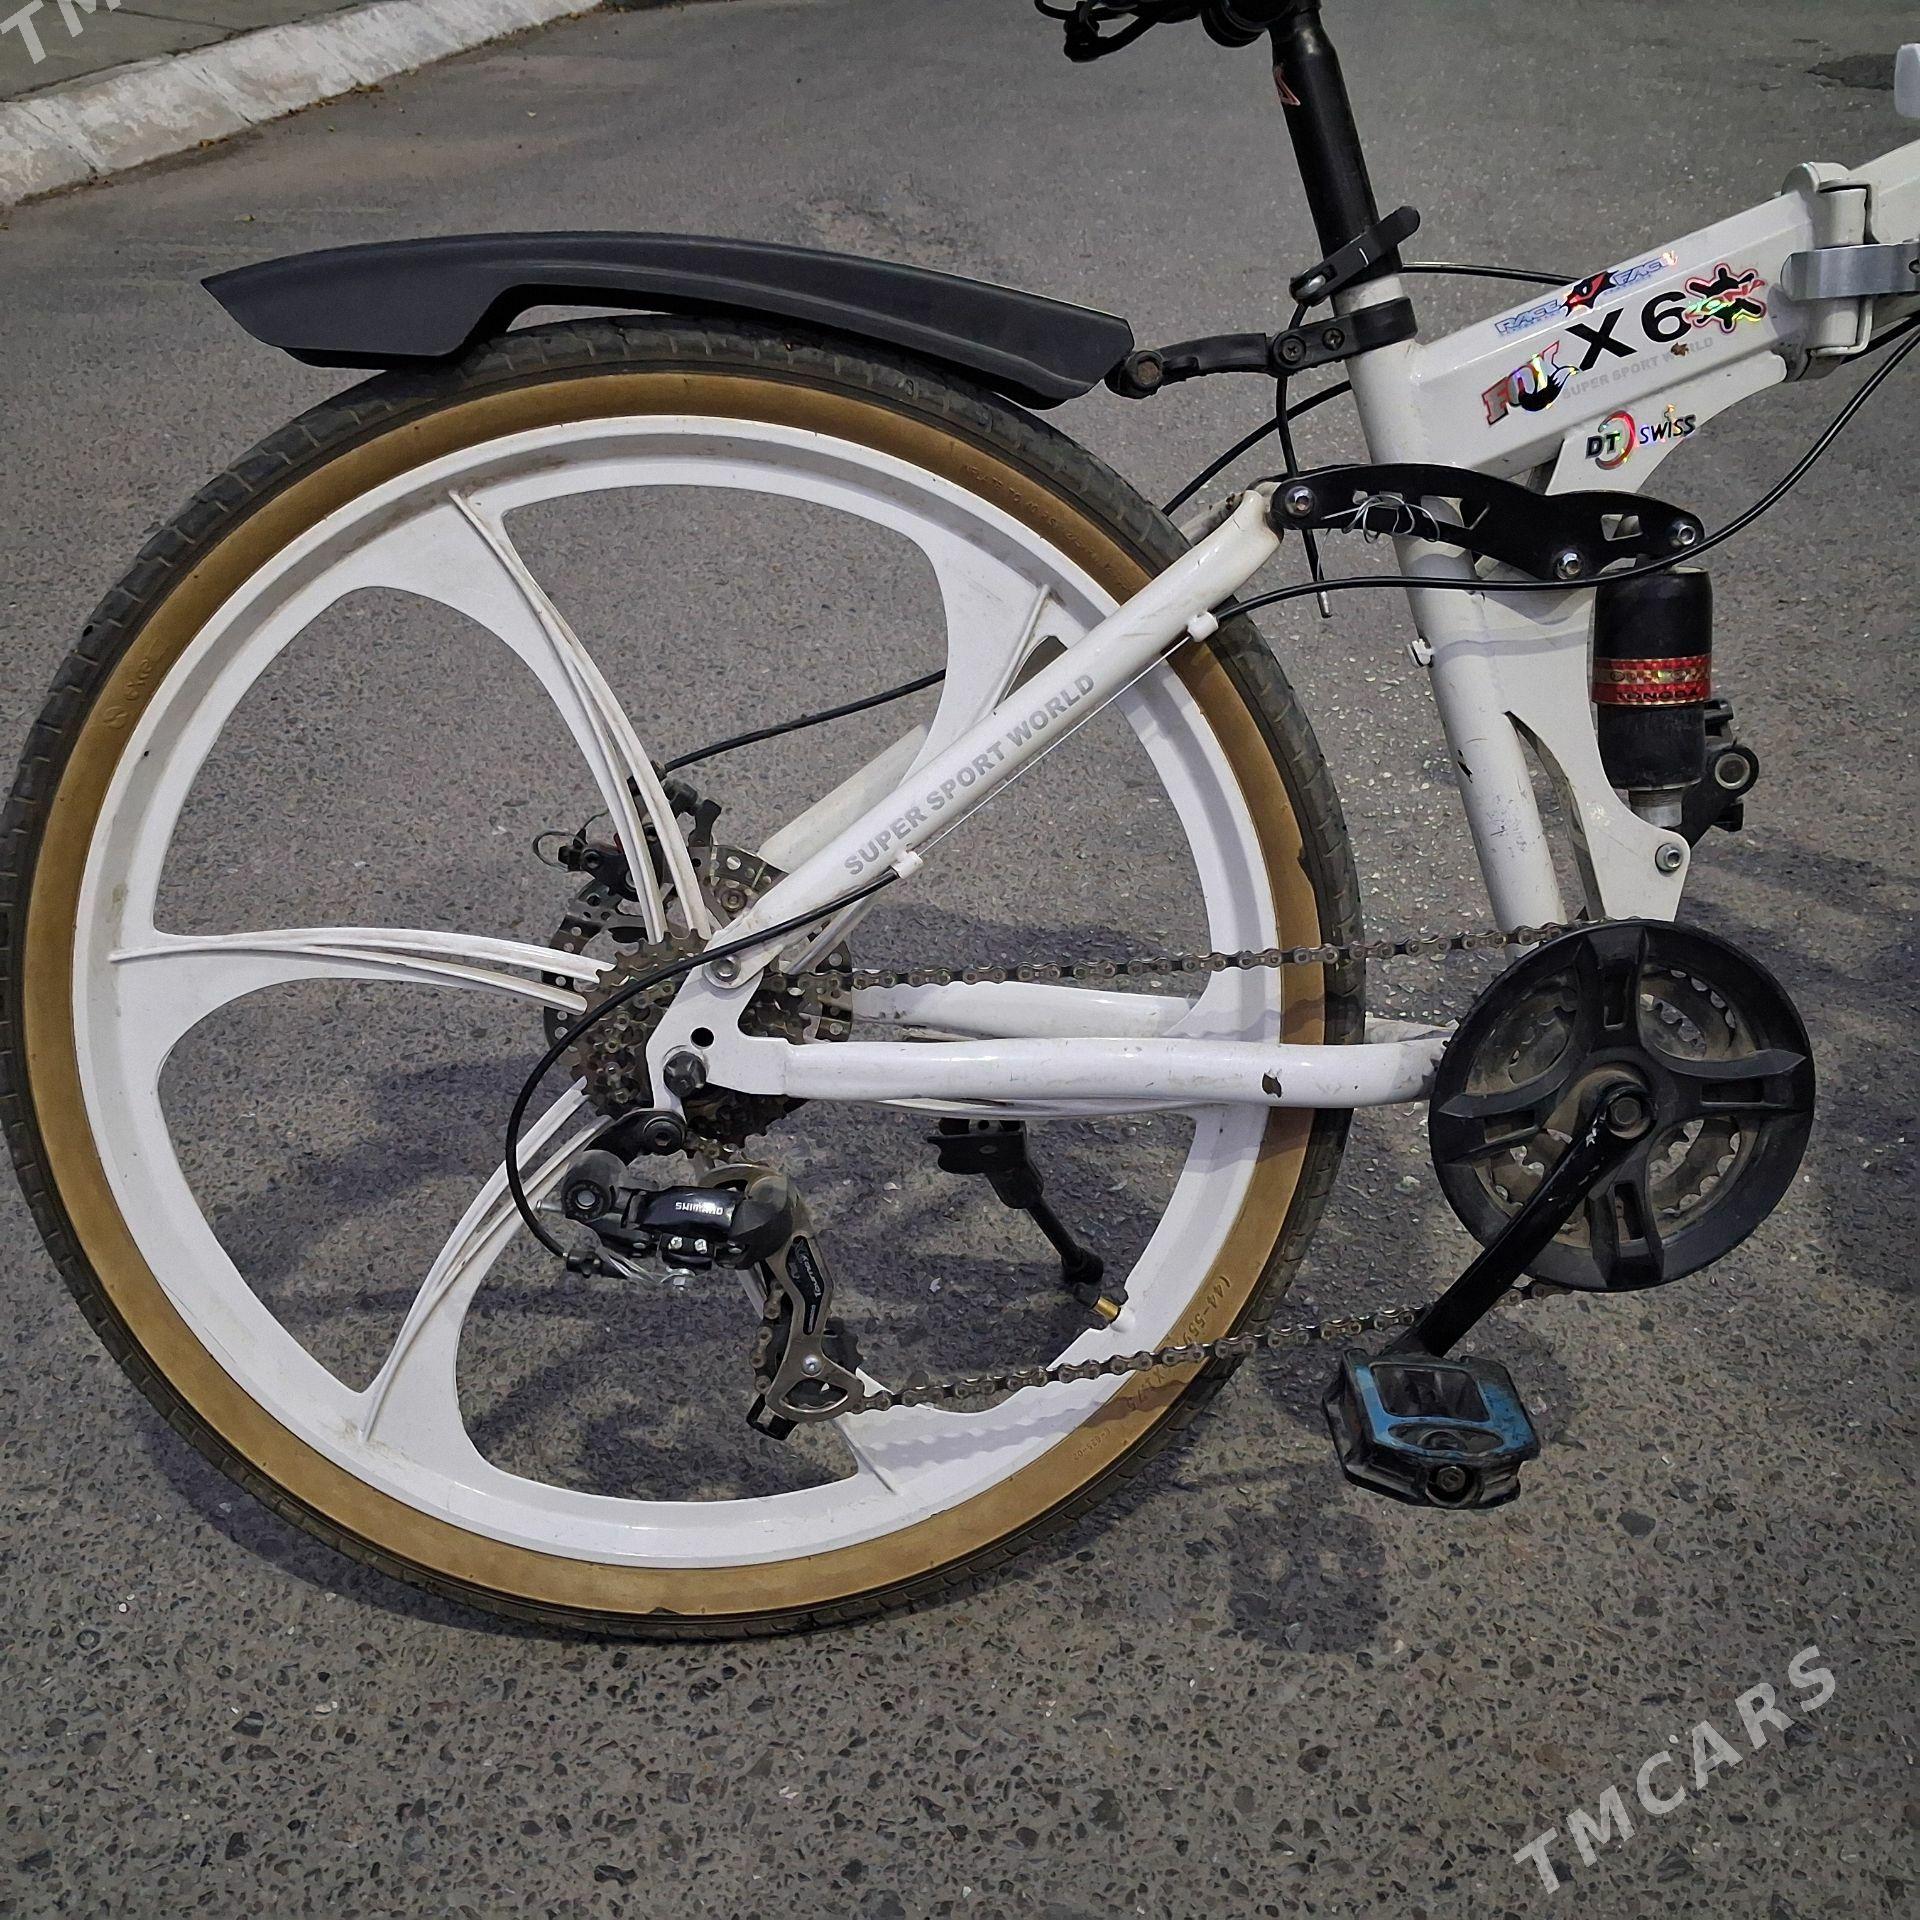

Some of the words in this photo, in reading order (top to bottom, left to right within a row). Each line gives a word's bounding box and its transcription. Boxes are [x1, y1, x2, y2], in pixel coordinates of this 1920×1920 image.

[1494, 299, 1561, 334] RACE
[1563, 374, 1610, 399] SUPER
[1612, 355, 1659, 378] SPORT
[1661, 337, 1714, 363] WRLD
[1585, 432, 1620, 459] DT
[1640, 414, 1697, 445] SWISS
[844, 805, 928, 876] SUPER
[926, 741, 1005, 812] SPORT
[1006, 674, 1095, 747] WORLD
